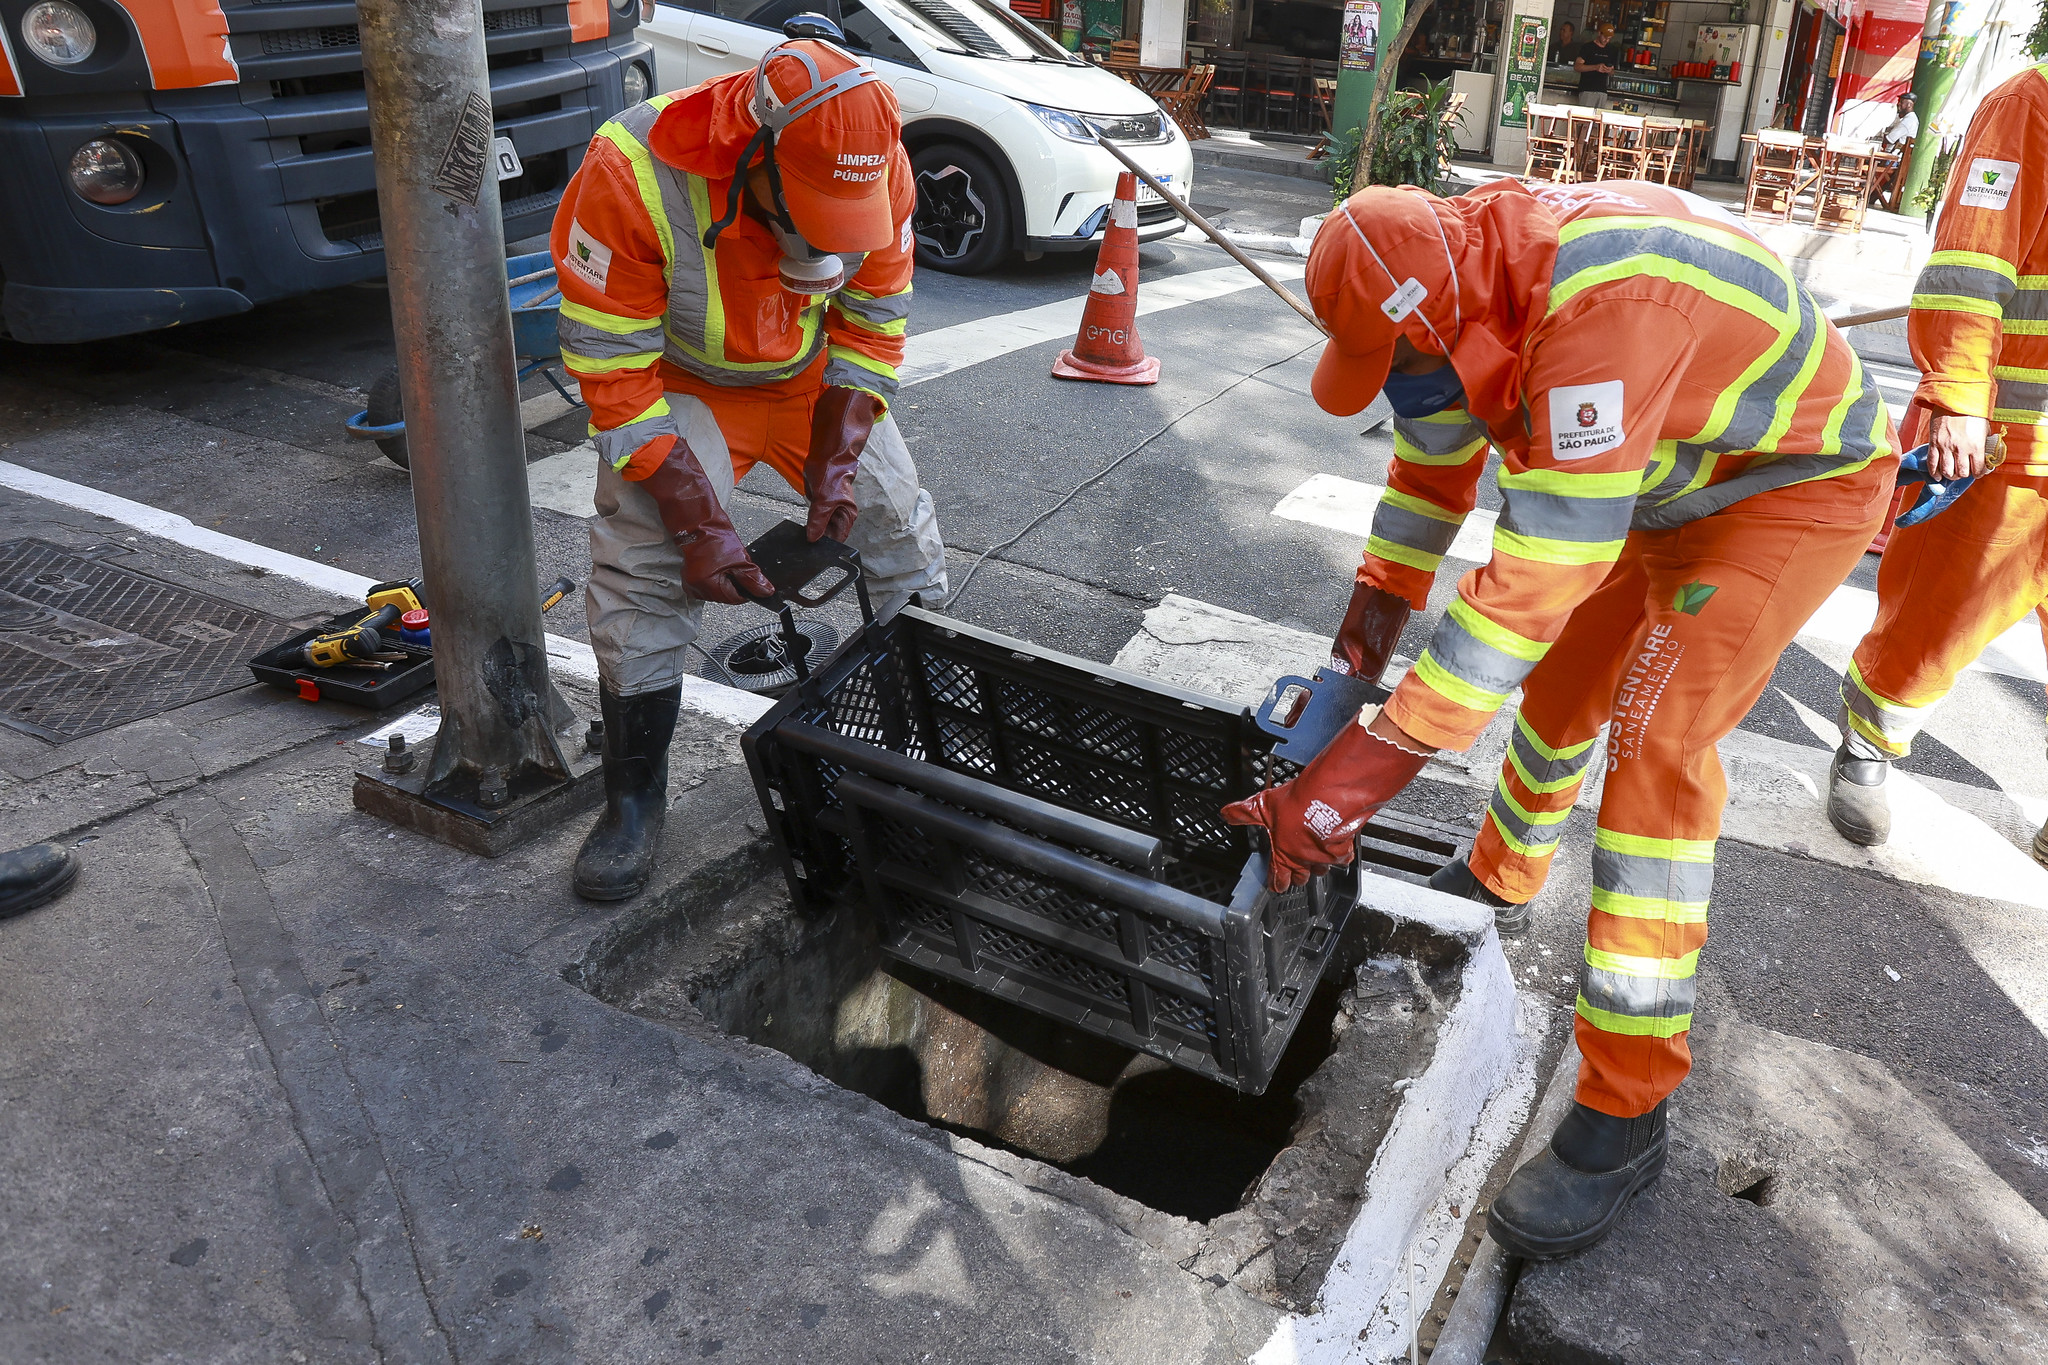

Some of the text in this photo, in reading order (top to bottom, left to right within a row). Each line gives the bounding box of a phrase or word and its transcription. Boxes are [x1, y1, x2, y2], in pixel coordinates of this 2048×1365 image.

[1510, 73, 1538, 84] BEATS
[837, 153, 886, 166] LIMPEZA
[833, 169, 882, 182] PÚBLICA
[1966, 185, 2009, 198] SUSTENTARE
[1086, 325, 1129, 345] enel
[1558, 426, 1615, 440] PREFEITURA DE
[1559, 434, 1616, 450] SÃO PAULO
[1607, 623, 1673, 772] SUSTENTARE
[1621, 640, 1679, 760] SANEAMENTO
